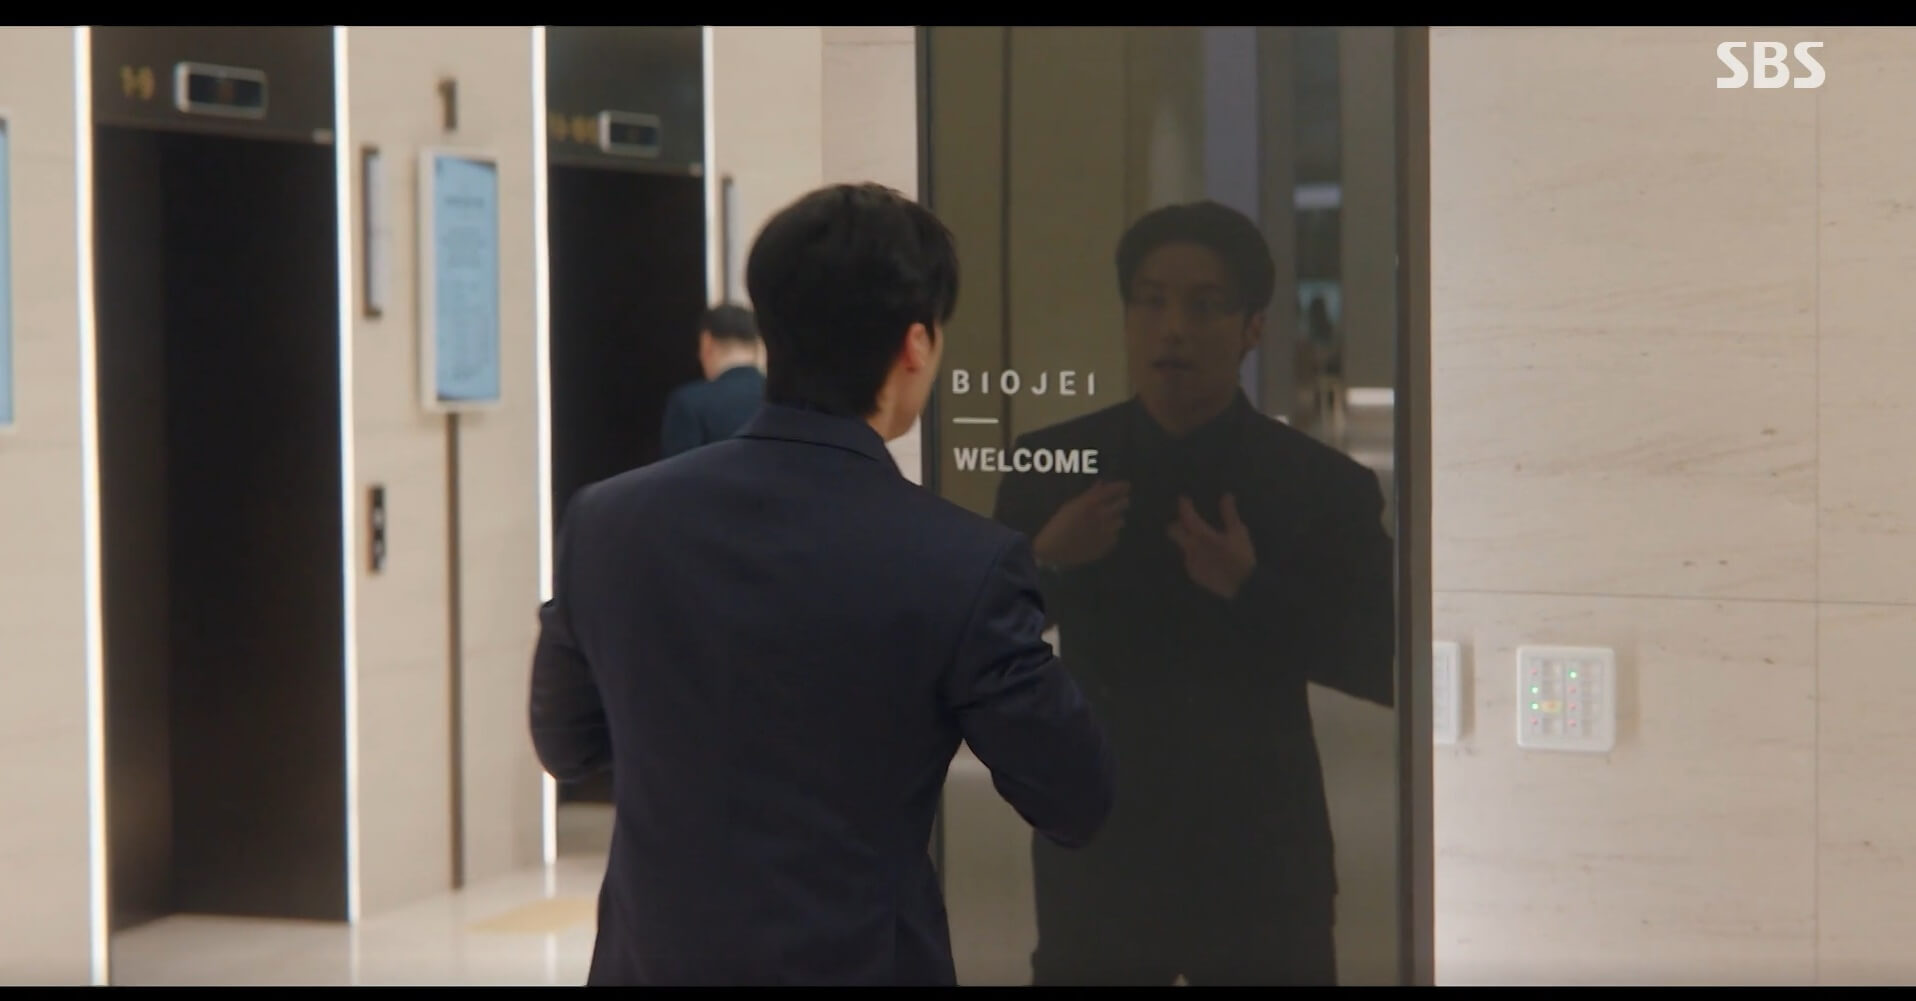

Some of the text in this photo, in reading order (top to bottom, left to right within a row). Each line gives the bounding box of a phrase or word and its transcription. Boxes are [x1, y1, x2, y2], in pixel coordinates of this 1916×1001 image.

[437, 78, 458, 131] 1
[952, 369, 1096, 396] BIOJEI
[953, 447, 1099, 474] WELCOME
